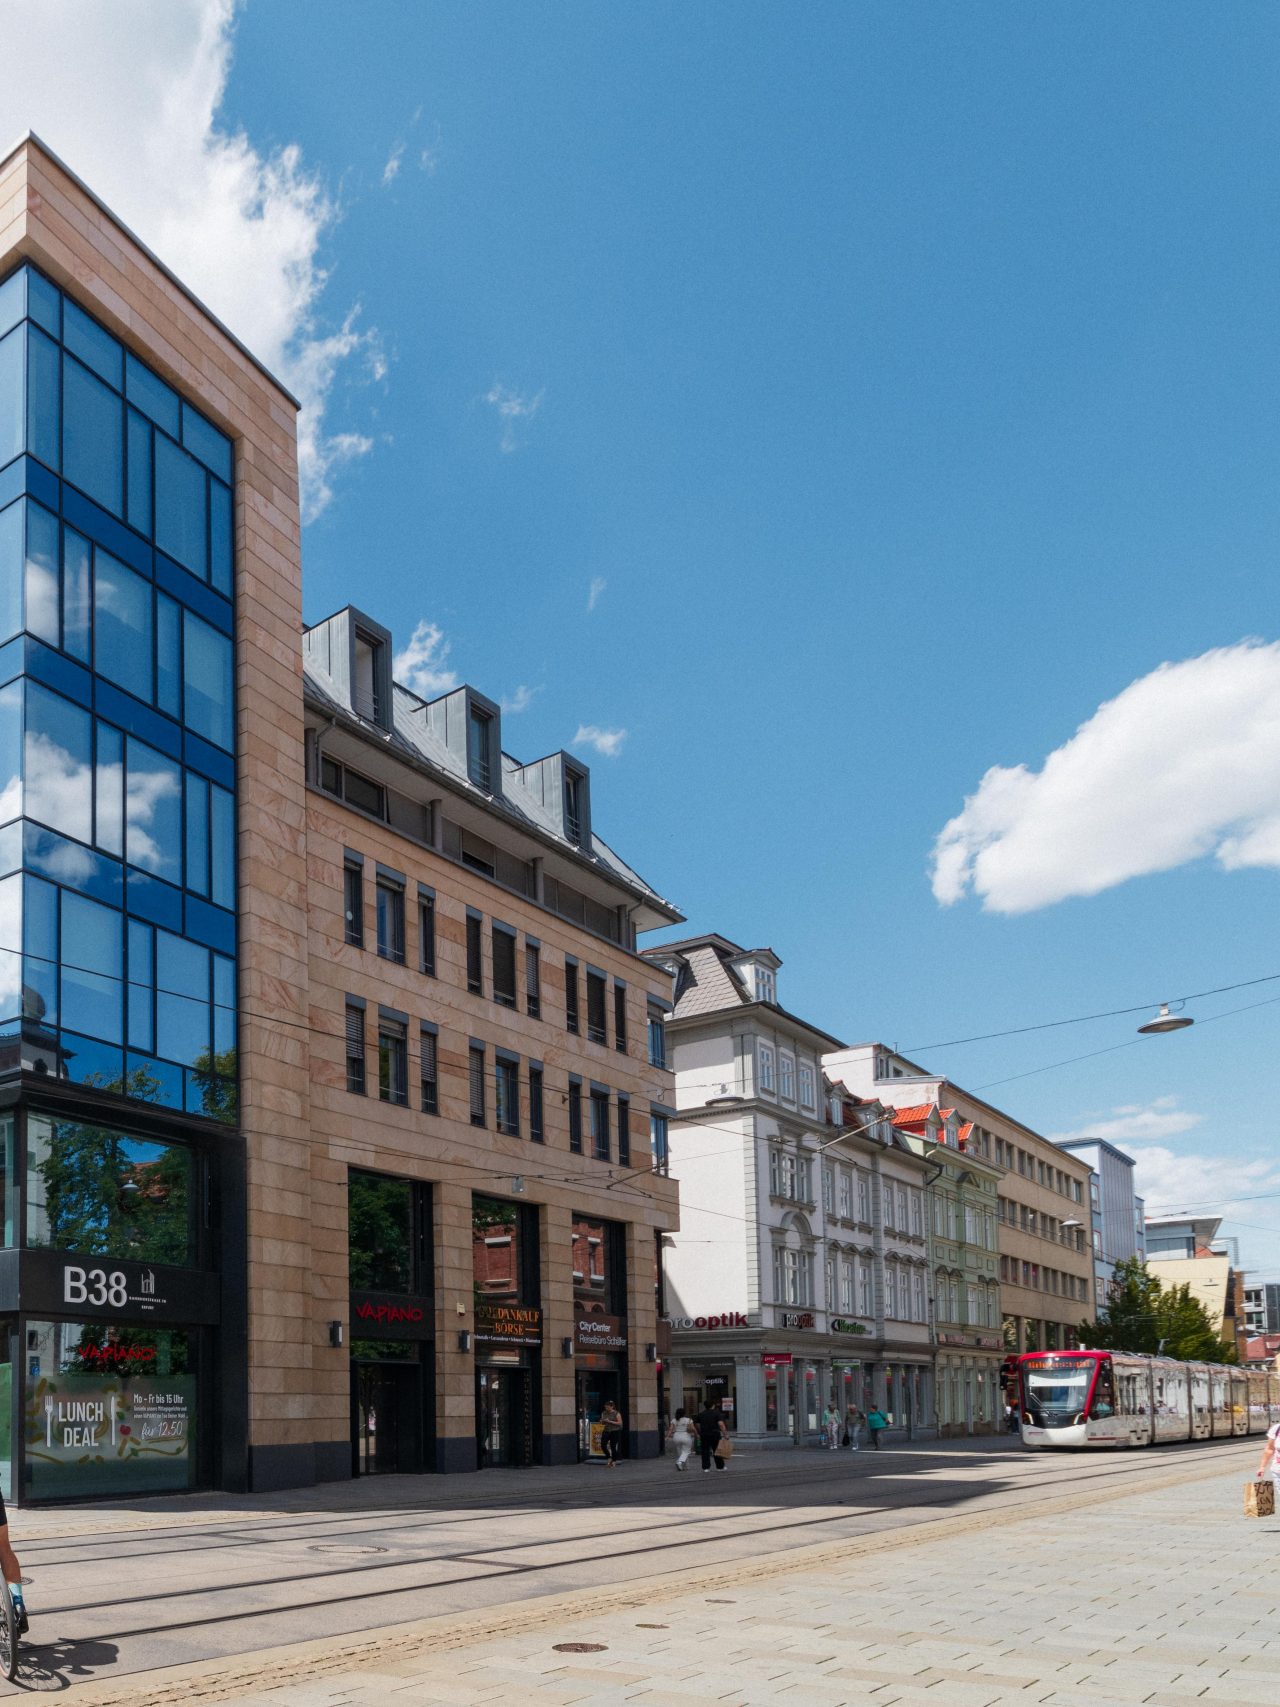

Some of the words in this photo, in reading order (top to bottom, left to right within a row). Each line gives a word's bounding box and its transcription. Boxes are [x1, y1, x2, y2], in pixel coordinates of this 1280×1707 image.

[64, 1266, 127, 1307] B38
[356, 1300, 423, 1325] VAPIANO
[495, 1320, 524, 1336] BÖRSE
[580, 1321, 592, 1333] City
[592, 1322, 611, 1333] Center
[579, 1334, 607, 1345] Reisebüro
[79, 1344, 155, 1361] VAPIANO
[134, 1394, 143, 1404] Mo
[149, 1394, 155, 1404] Fr
[156, 1394, 165, 1404] bis
[166, 1395, 173, 1404] 15
[173, 1395, 184, 1404] Uhr
[58, 1402, 104, 1423] LUNCH
[63, 1426, 99, 1448] DEAL
